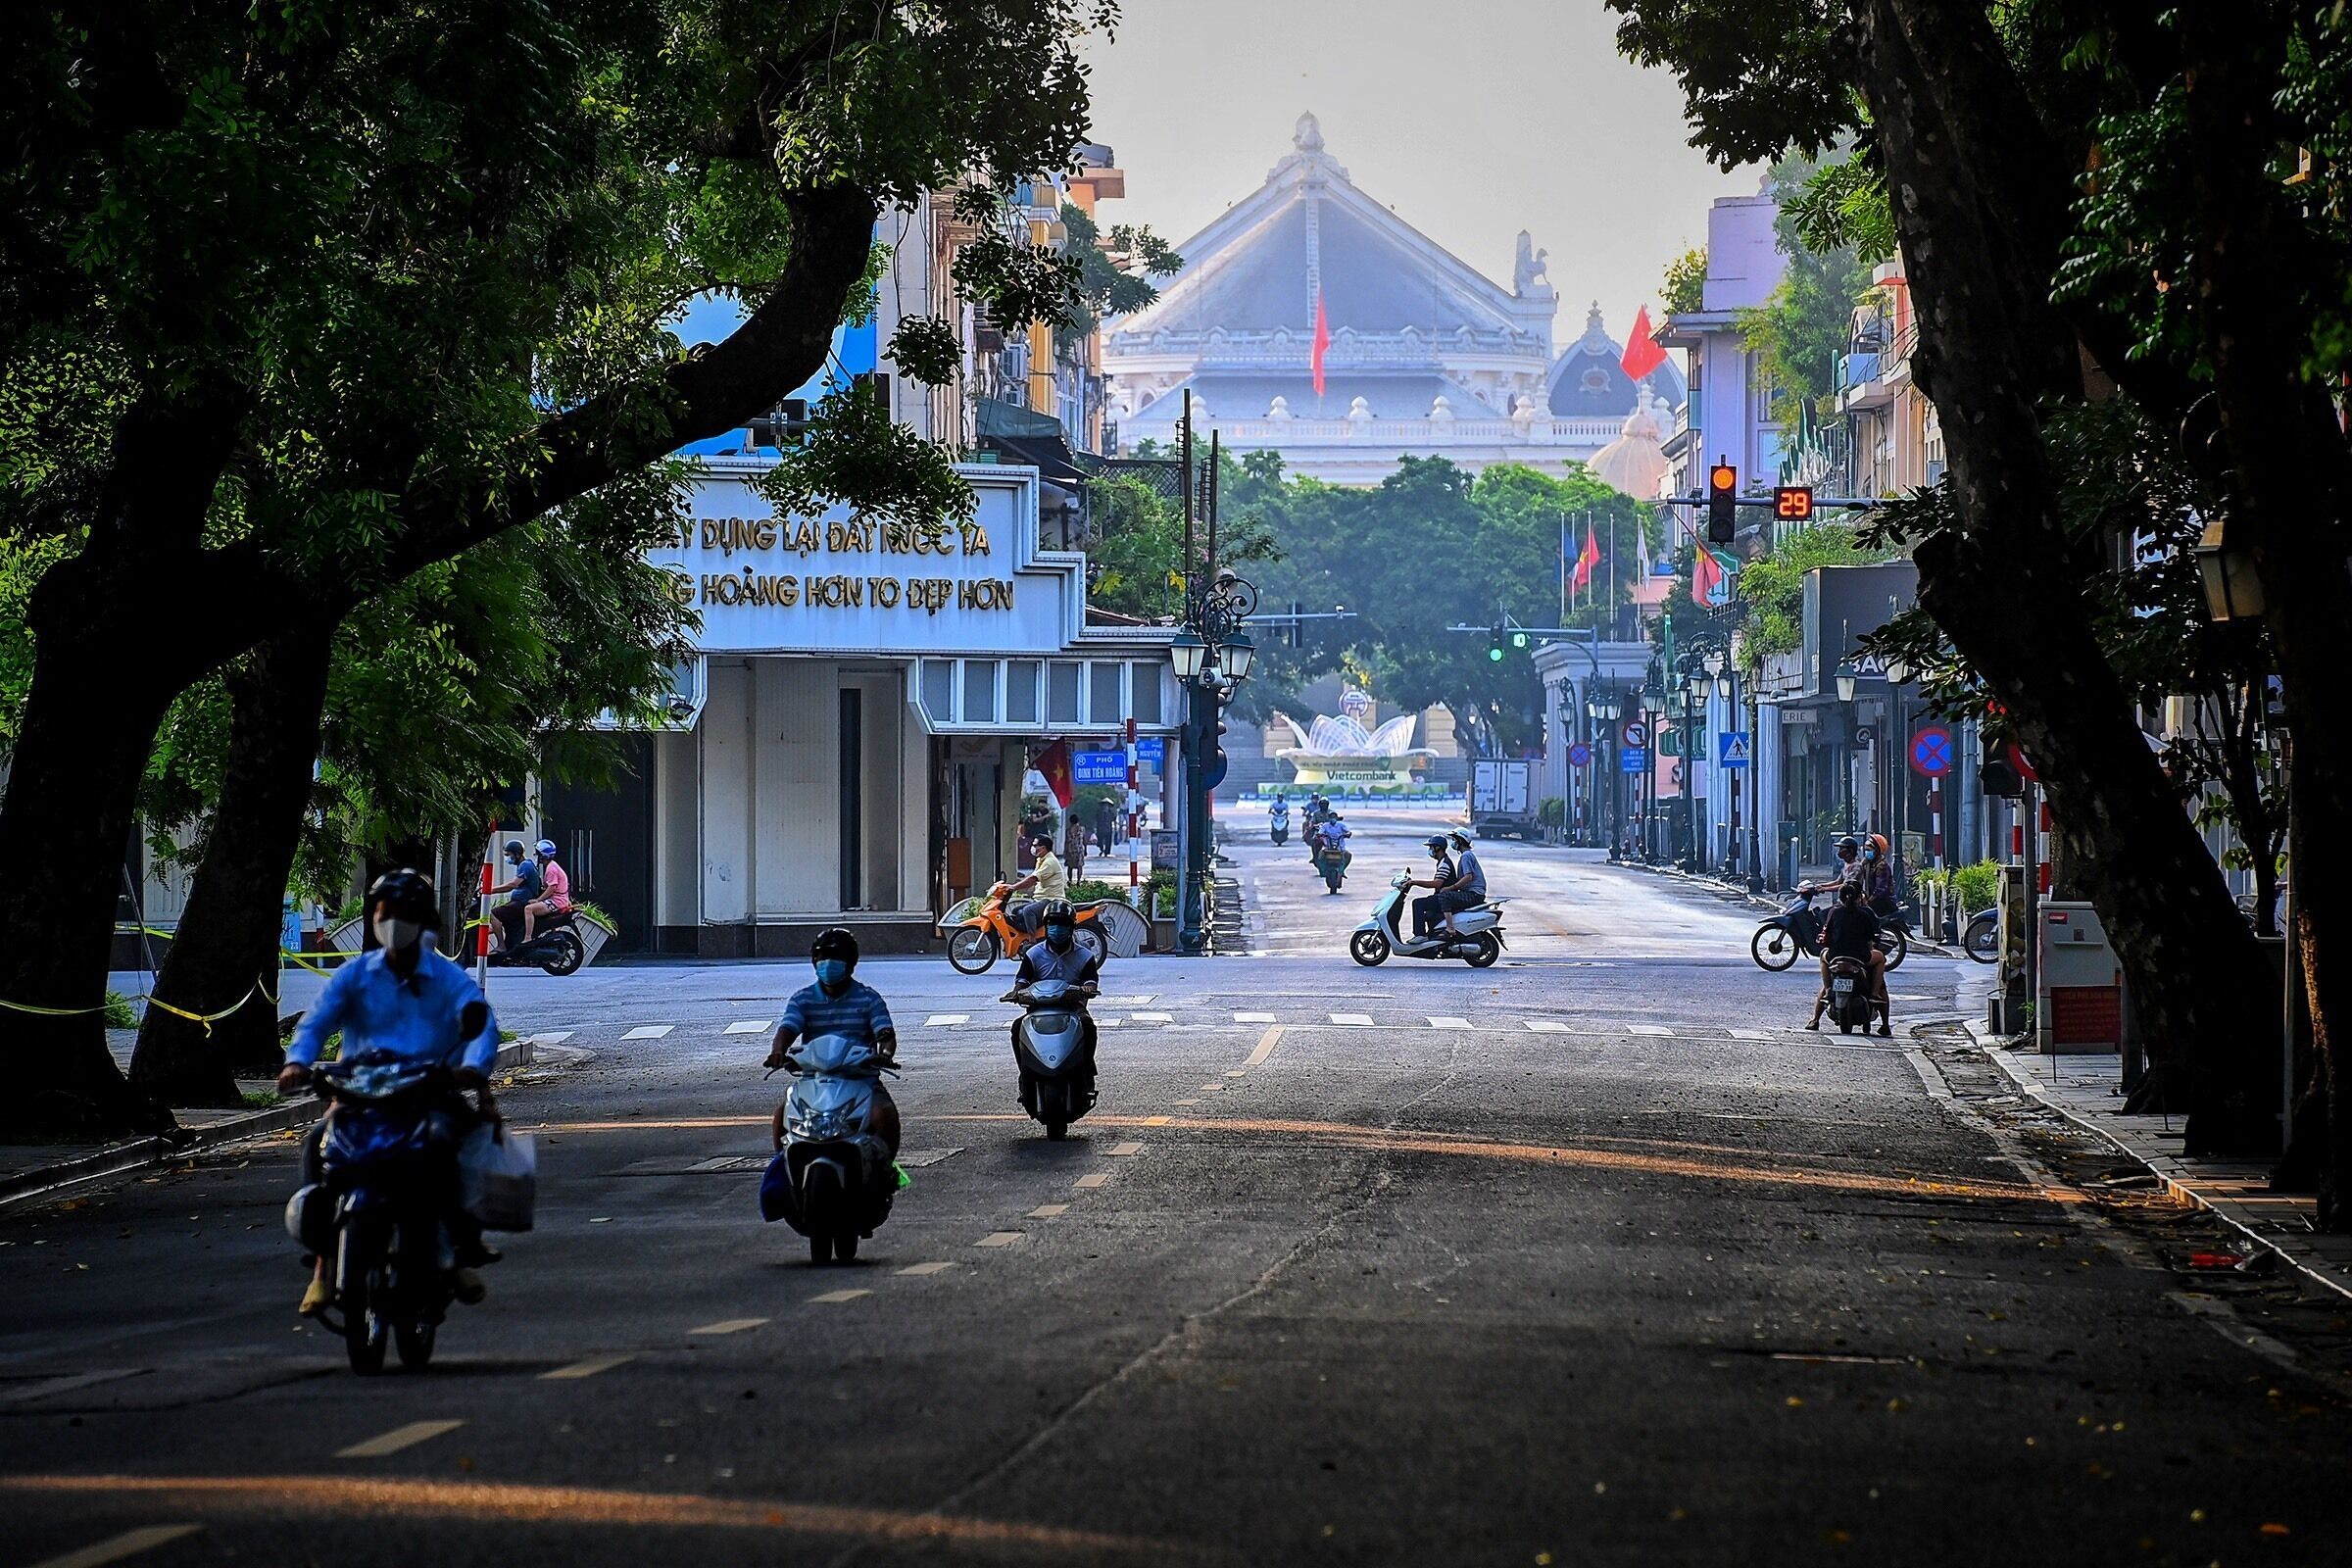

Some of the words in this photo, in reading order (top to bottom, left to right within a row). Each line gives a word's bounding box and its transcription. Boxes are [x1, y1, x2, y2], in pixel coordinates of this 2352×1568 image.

[1780, 492, 1807, 515] 29
[702, 517, 777, 557] DỰNG
[783, 520, 820, 558] LẠI
[959, 524, 991, 556] TA
[702, 565, 801, 606] HOÀNG
[806, 574, 863, 608] HƠN
[867, 577, 901, 608] TO
[906, 579, 954, 616] ĐẸP
[958, 578, 1013, 611] HƠN
[1327, 770, 1396, 780] Vietcombank
